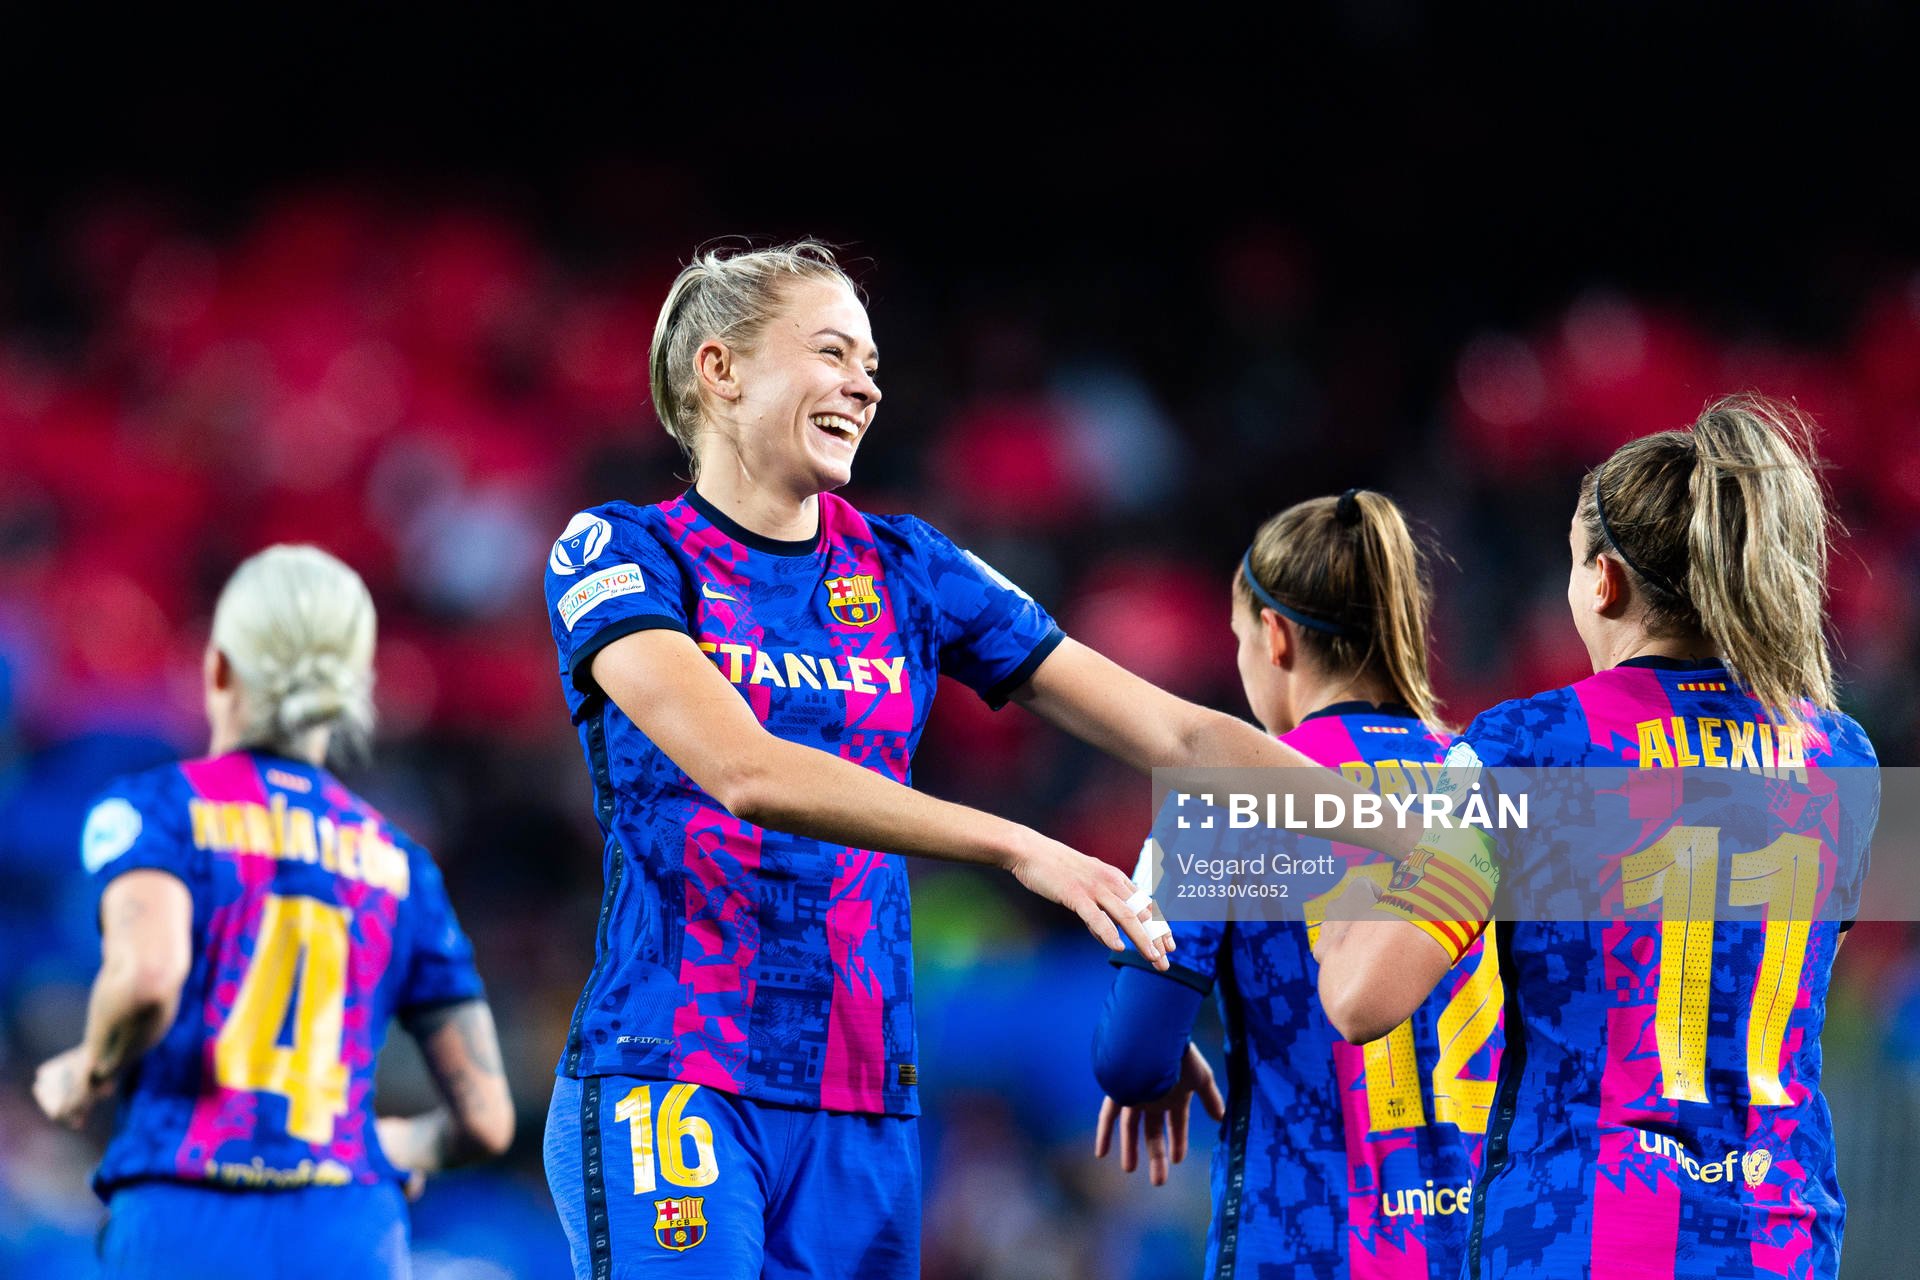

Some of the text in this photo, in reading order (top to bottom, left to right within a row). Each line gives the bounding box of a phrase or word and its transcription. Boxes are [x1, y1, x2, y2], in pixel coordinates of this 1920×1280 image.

[844, 597, 865, 605] FCB
[1636, 716, 1809, 785] ALEXIA
[1469, 853, 1491, 873] NO
[1621, 826, 1822, 1106] 11
[215, 895, 353, 1145] 4
[614, 1083, 720, 1195] 16
[1640, 1130, 1738, 1183] unicef
[669, 1219, 690, 1227] FCB
[1382, 1179, 1473, 1217] unice
